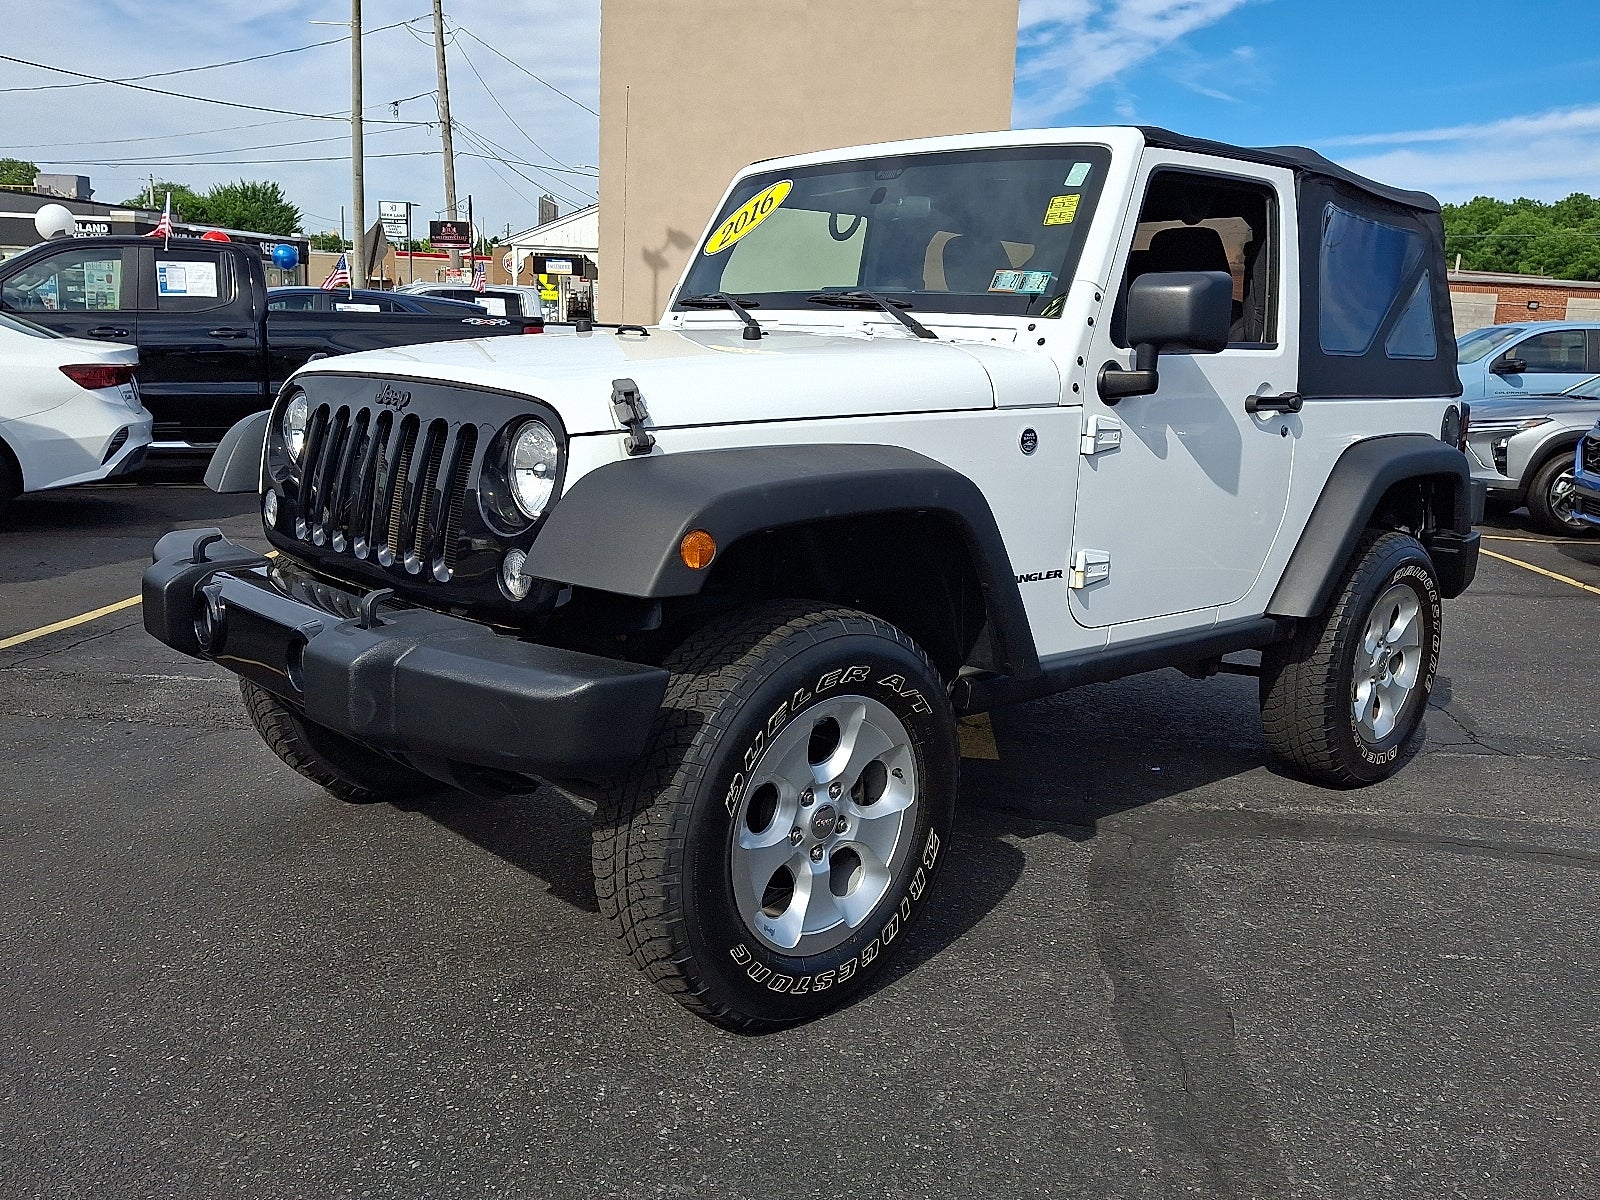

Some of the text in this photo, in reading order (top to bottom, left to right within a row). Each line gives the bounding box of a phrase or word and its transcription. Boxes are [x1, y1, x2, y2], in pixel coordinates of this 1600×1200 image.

[719, 186, 776, 248] 2016
[375, 383, 412, 411] Jeep
[1391, 565, 1441, 694] BRIDGESTONE
[725, 665, 934, 818] DUELER A/T
[729, 826, 941, 995] BRIDGESTONE
